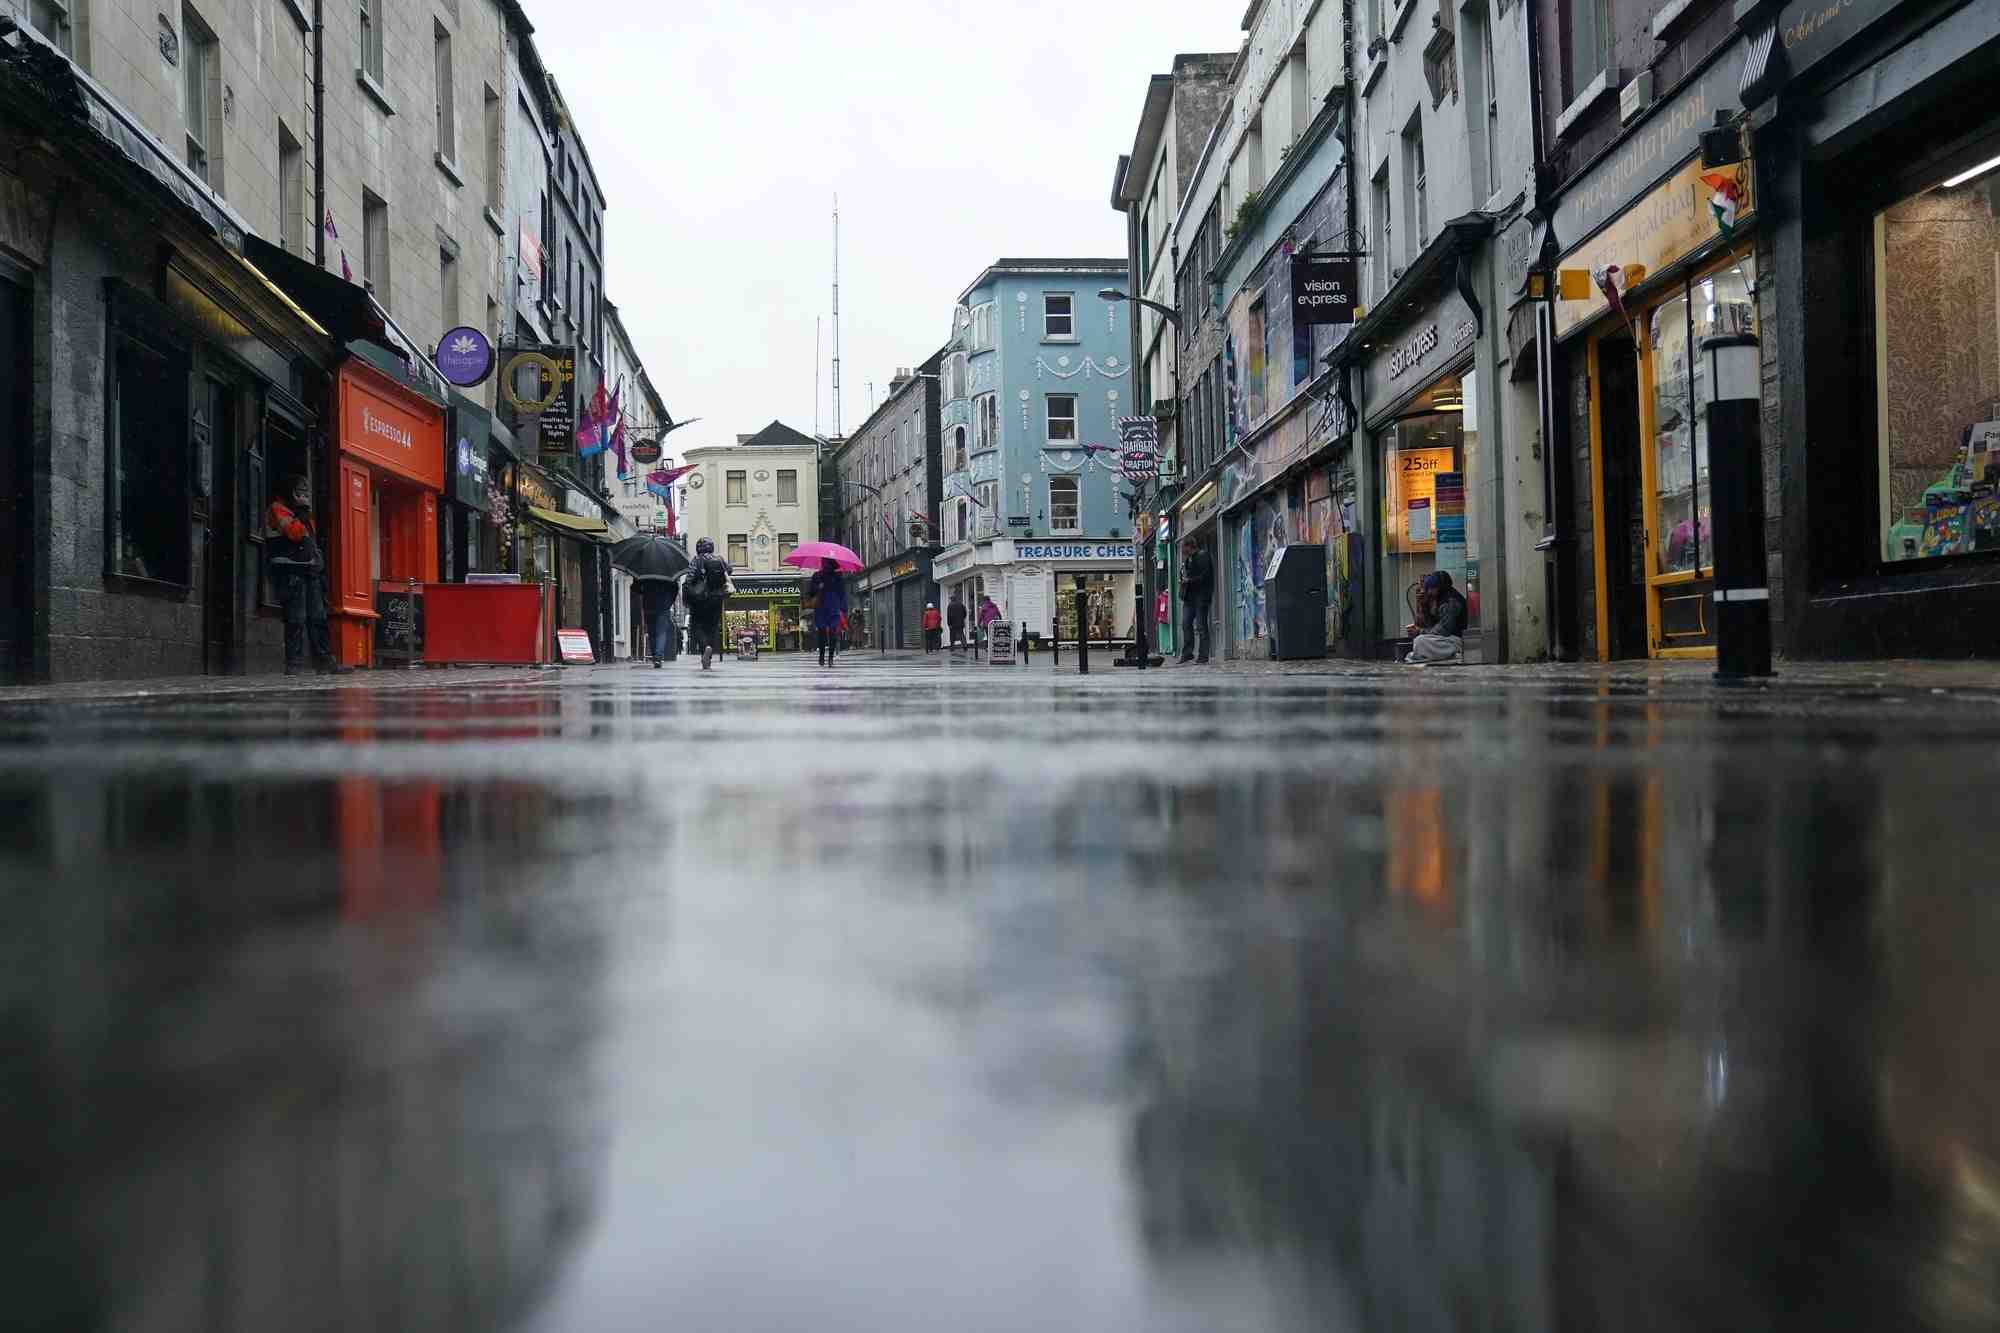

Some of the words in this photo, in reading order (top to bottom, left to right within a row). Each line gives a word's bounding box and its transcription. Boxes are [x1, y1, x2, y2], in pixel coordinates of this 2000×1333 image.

[1304, 279, 1341, 292] vision
[1297, 294, 1348, 308] express
[370, 416, 401, 443] ESPRESSO
[401, 429, 412, 448] 44
[1016, 546, 1090, 558] TREASURE
[1097, 545, 1135, 557] CHES
[761, 586, 801, 594] CAMERA
